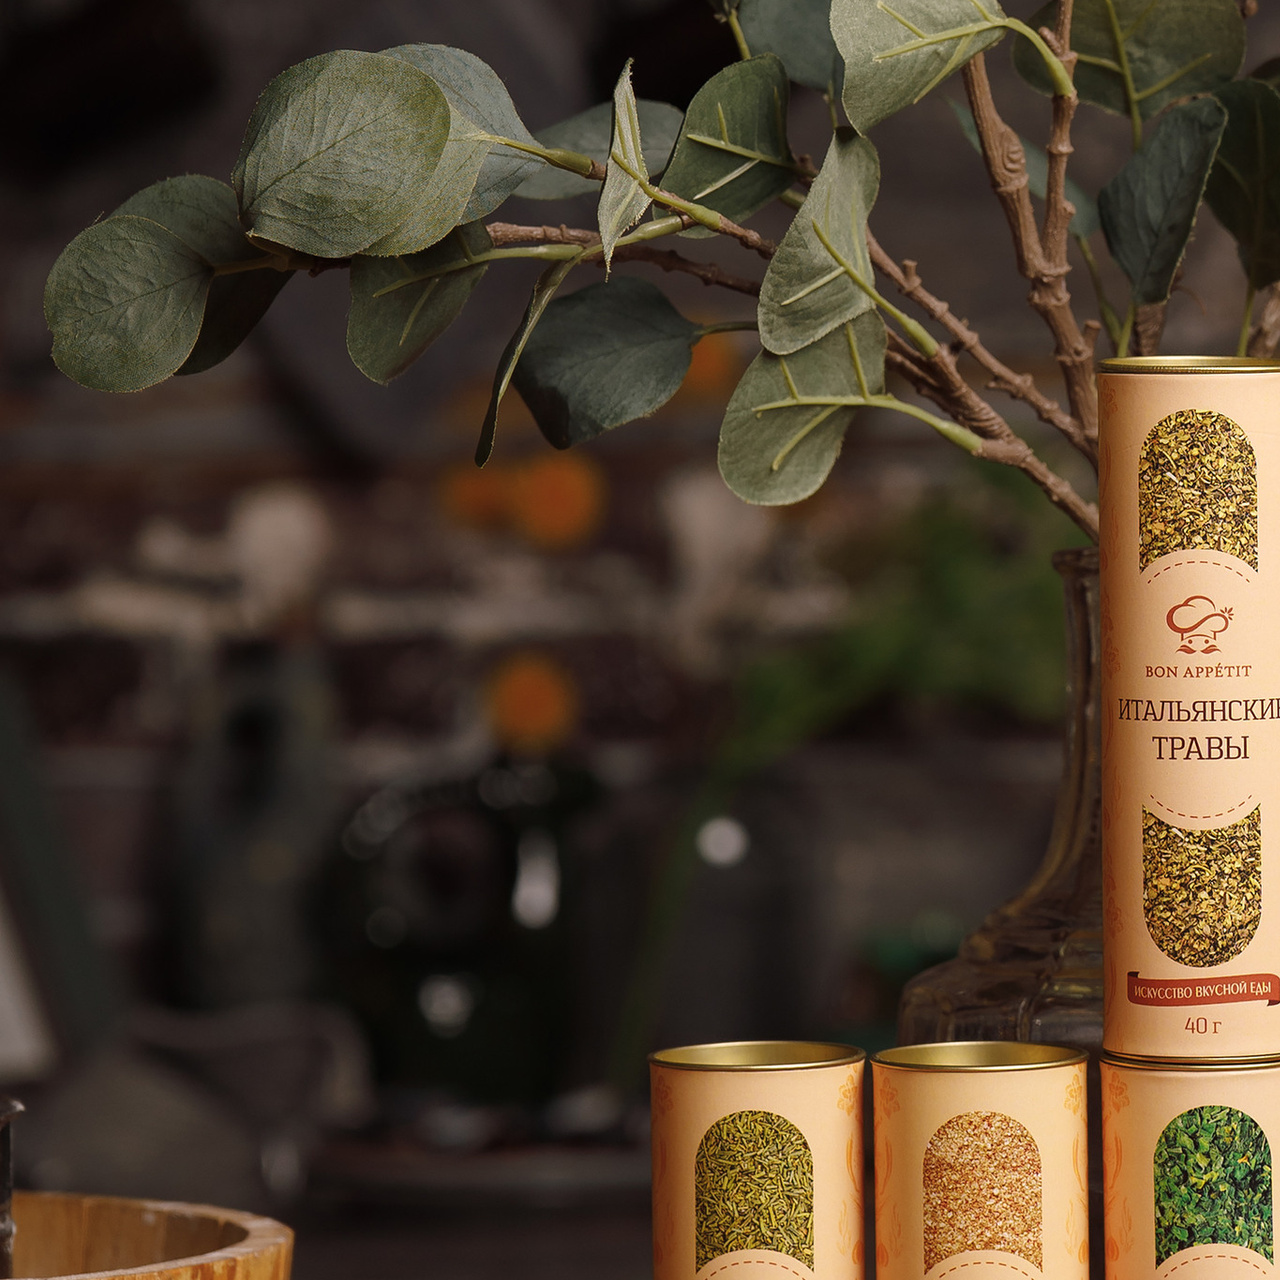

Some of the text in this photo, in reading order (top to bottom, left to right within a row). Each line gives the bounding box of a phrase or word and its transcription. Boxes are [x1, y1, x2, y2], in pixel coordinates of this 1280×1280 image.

[1145, 662, 1252, 678] BON APPÉTIT
[1151, 735, 1250, 761] ТРАВЫ
[1134, 980, 1272, 1000] ИСКУССТВО ВКУСНОЙ ЕДЫ
[1184, 1016, 1223, 1035] 40 г
